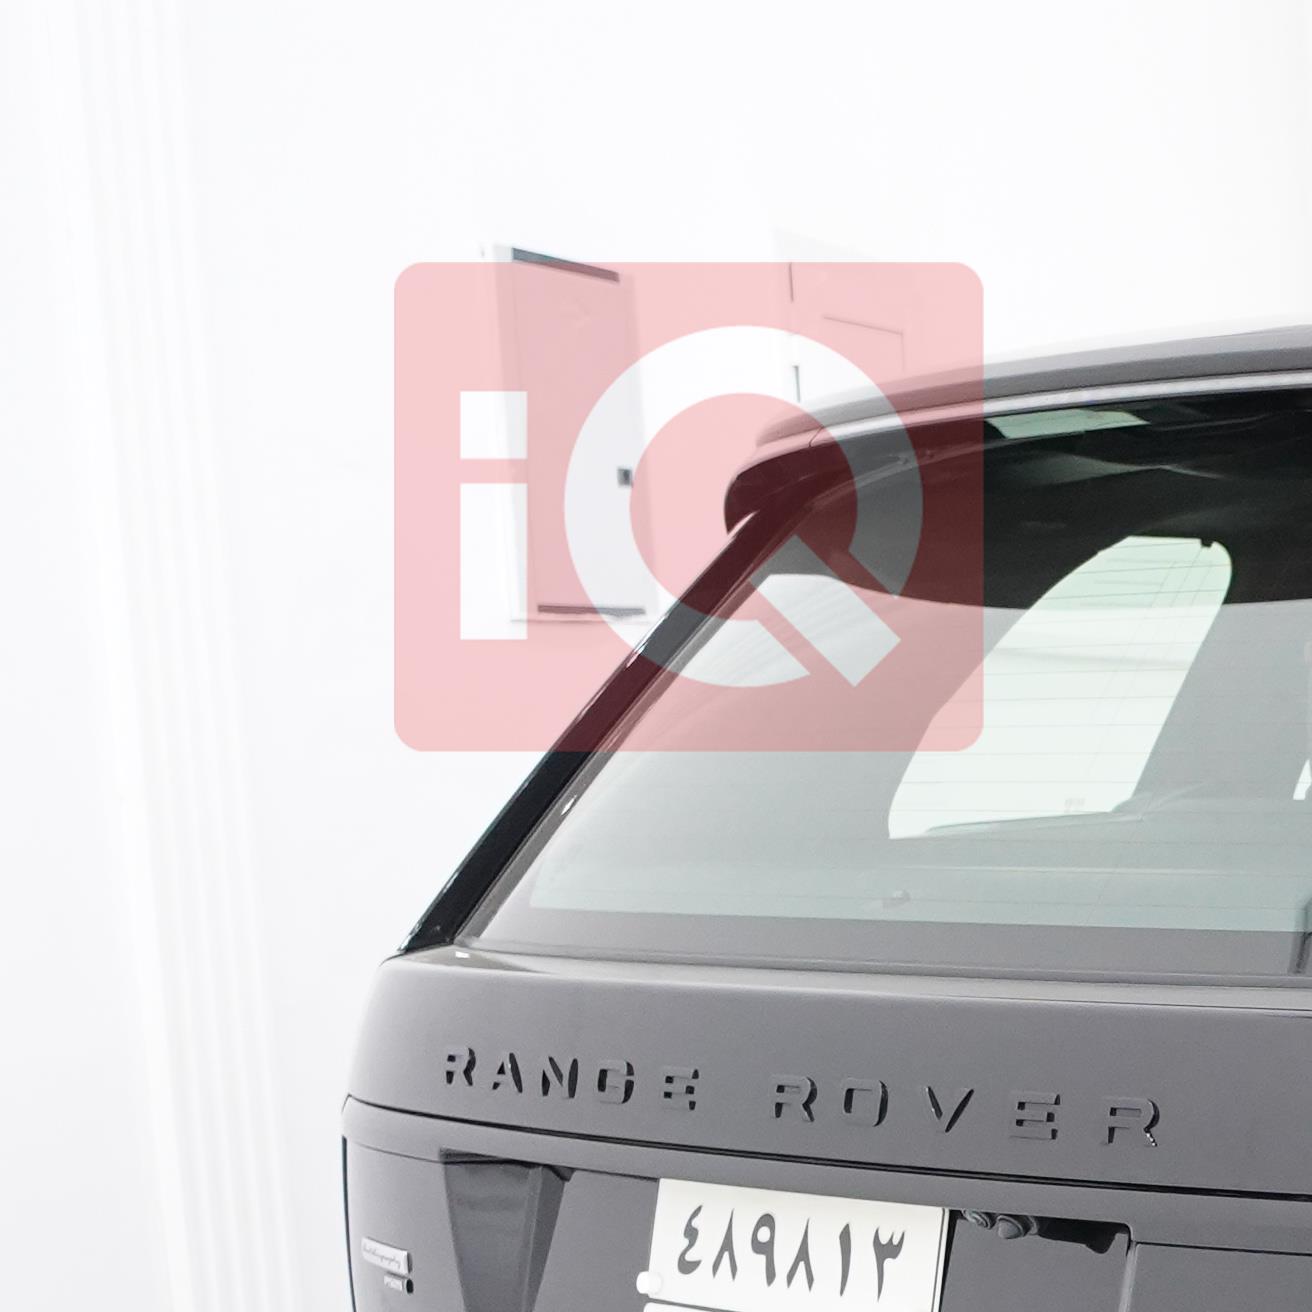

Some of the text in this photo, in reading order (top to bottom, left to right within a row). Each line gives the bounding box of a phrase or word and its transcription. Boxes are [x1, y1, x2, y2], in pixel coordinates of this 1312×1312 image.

[445, 1046, 1161, 1147] RANGE ROVER
[676, 1204, 906, 1302] ٤٨٩٨١٣
